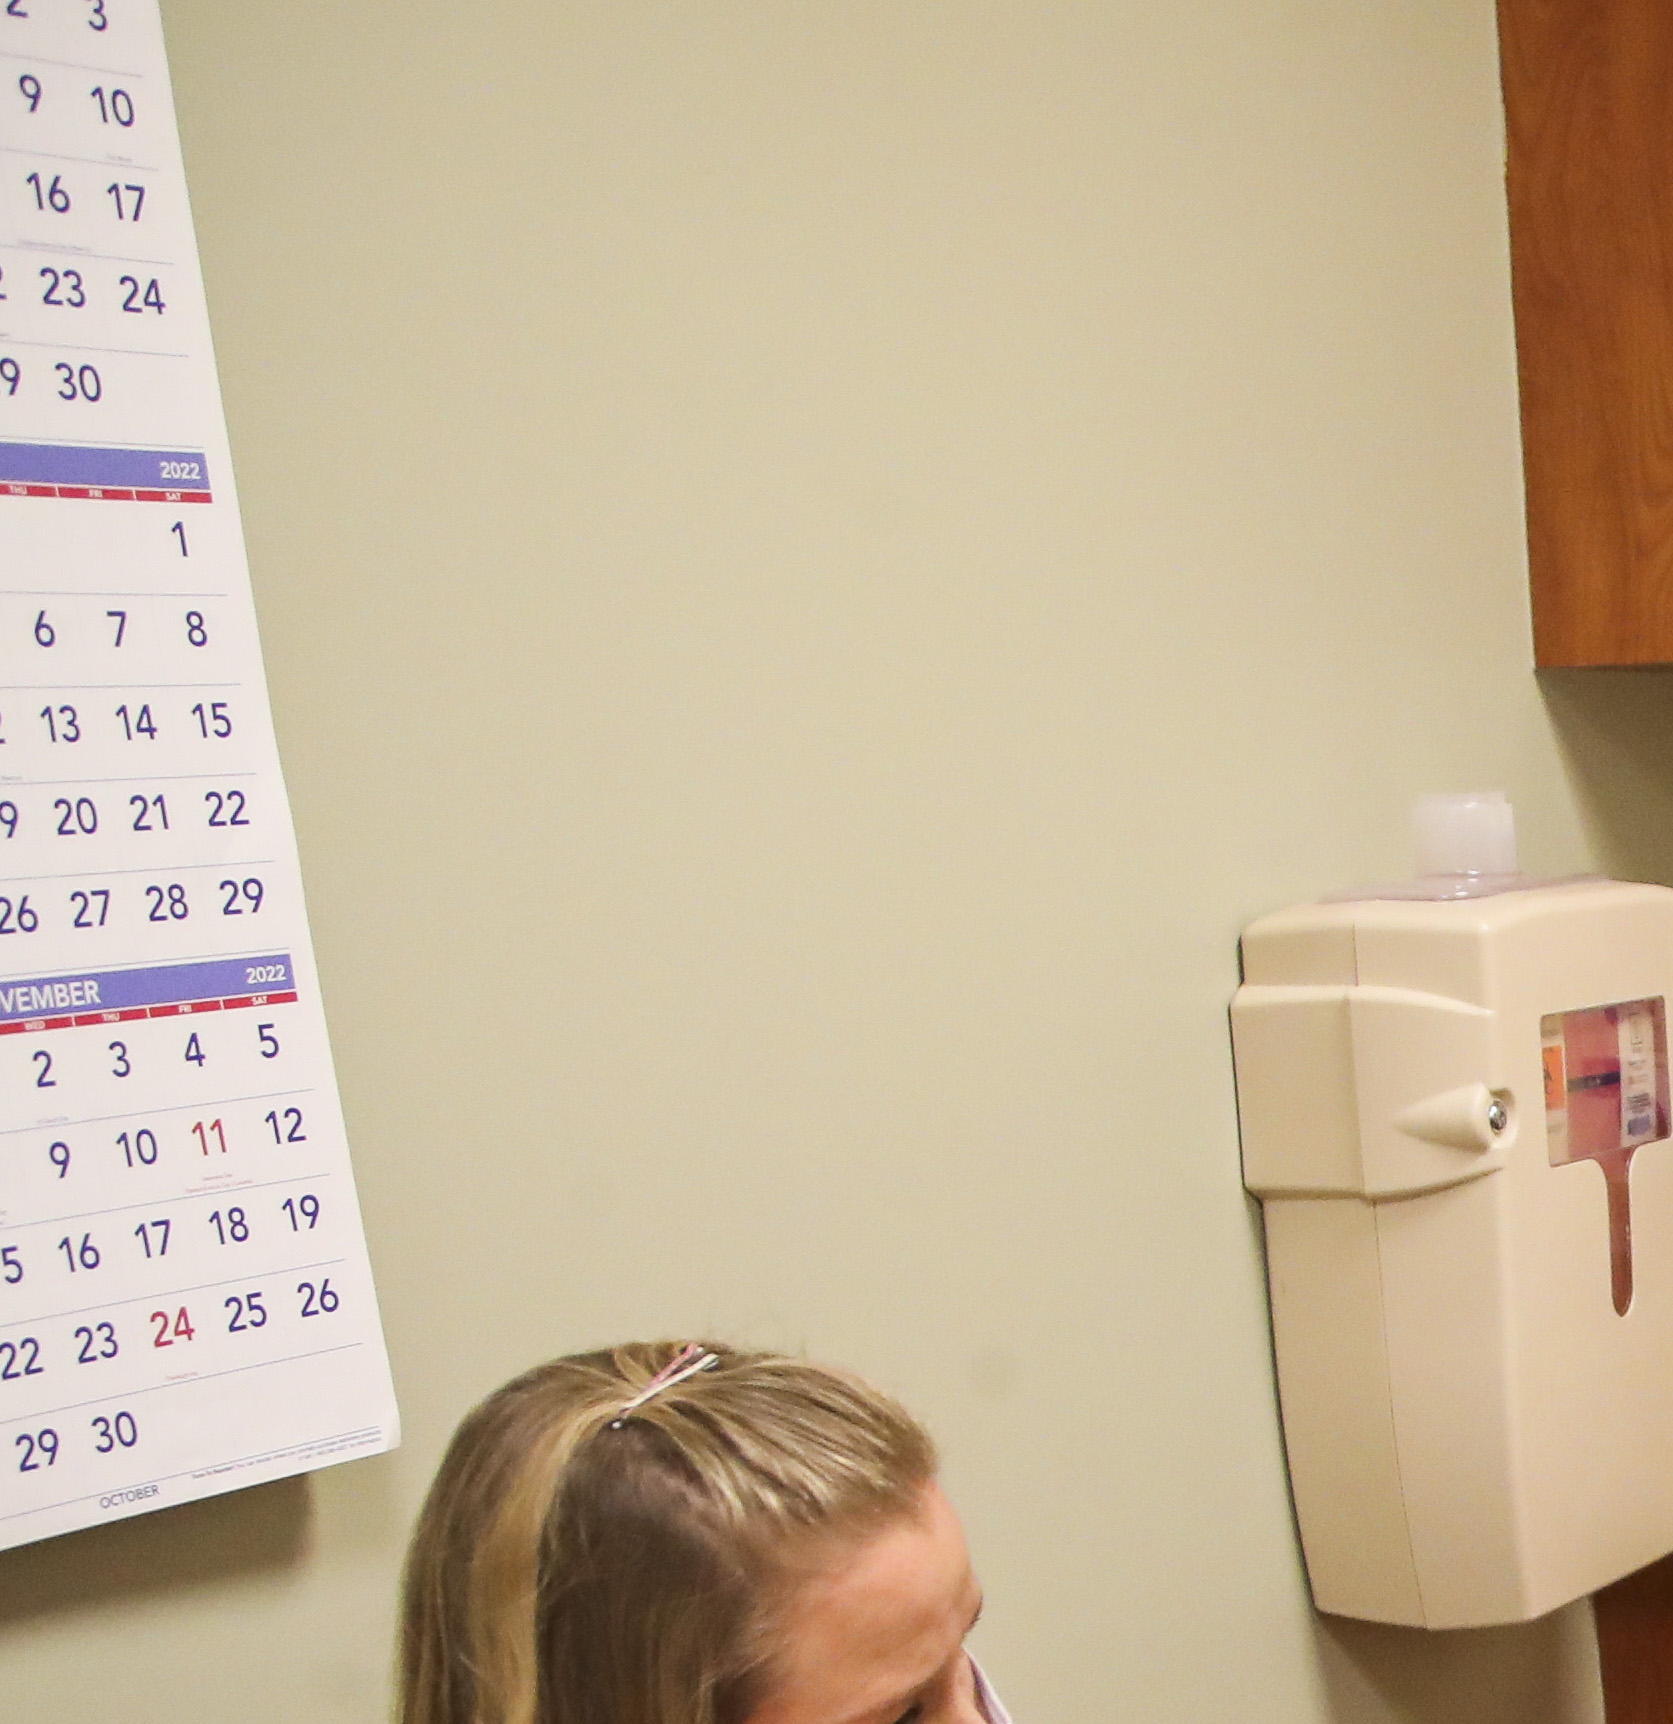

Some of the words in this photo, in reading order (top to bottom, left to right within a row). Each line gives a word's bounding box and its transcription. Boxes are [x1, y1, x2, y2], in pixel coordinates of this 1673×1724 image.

[87, 0, 107, 31] 3
[20, 75, 41, 112] 9
[91, 87, 134, 127] 10
[27, 173, 70, 213] 16
[108, 184, 145, 222] 17
[40, 267, 86, 308] 23
[120, 276, 166, 314] 24
[0, 358, 20, 396] 9
[56, 363, 102, 402] 30
[160, 461, 201, 480] 2022
[166, 492, 181, 501] SAT
[171, 522, 188, 556] 1
[34, 610, 55, 647] 6
[107, 611, 126, 646] 7
[186, 611, 207, 647] 8
[41, 705, 81, 742] 13
[116, 704, 158, 740] 14
[192, 702, 232, 738] 15
[0, 801, 18, 838] 9
[54, 797, 98, 835] 20
[130, 794, 169, 830] 21
[205, 791, 250, 827] 22
[0, 896, 39, 934] 26
[70, 890, 110, 927] 27
[145, 884, 189, 921] 28
[220, 879, 264, 914] 29
[0, 981, 101, 1014] VEMBER
[246, 964, 287, 984] 2022
[252, 996, 267, 1006] SAT
[33, 1051, 56, 1088] 2
[109, 1041, 131, 1078] 3
[184, 1032, 206, 1068] 4
[258, 1023, 279, 1059] 5
[50, 1142, 70, 1179] 9
[117, 1129, 158, 1168] 10
[192, 1119, 227, 1156] 11
[265, 1108, 307, 1144] 12
[3, 1247, 23, 1284] 5
[59, 1234, 100, 1273] 16
[135, 1220, 172, 1259] 17
[209, 1207, 249, 1245] 18
[282, 1195, 320, 1232] 19
[0, 1338, 44, 1380] 22
[75, 1322, 118, 1364] 23
[151, 1307, 195, 1348] 24
[225, 1293, 267, 1333] 25
[297, 1279, 339, 1317] 26
[16, 1428, 59, 1473] 29
[92, 1411, 138, 1454] 30
[99, 1484, 160, 1509] OCTOBER
